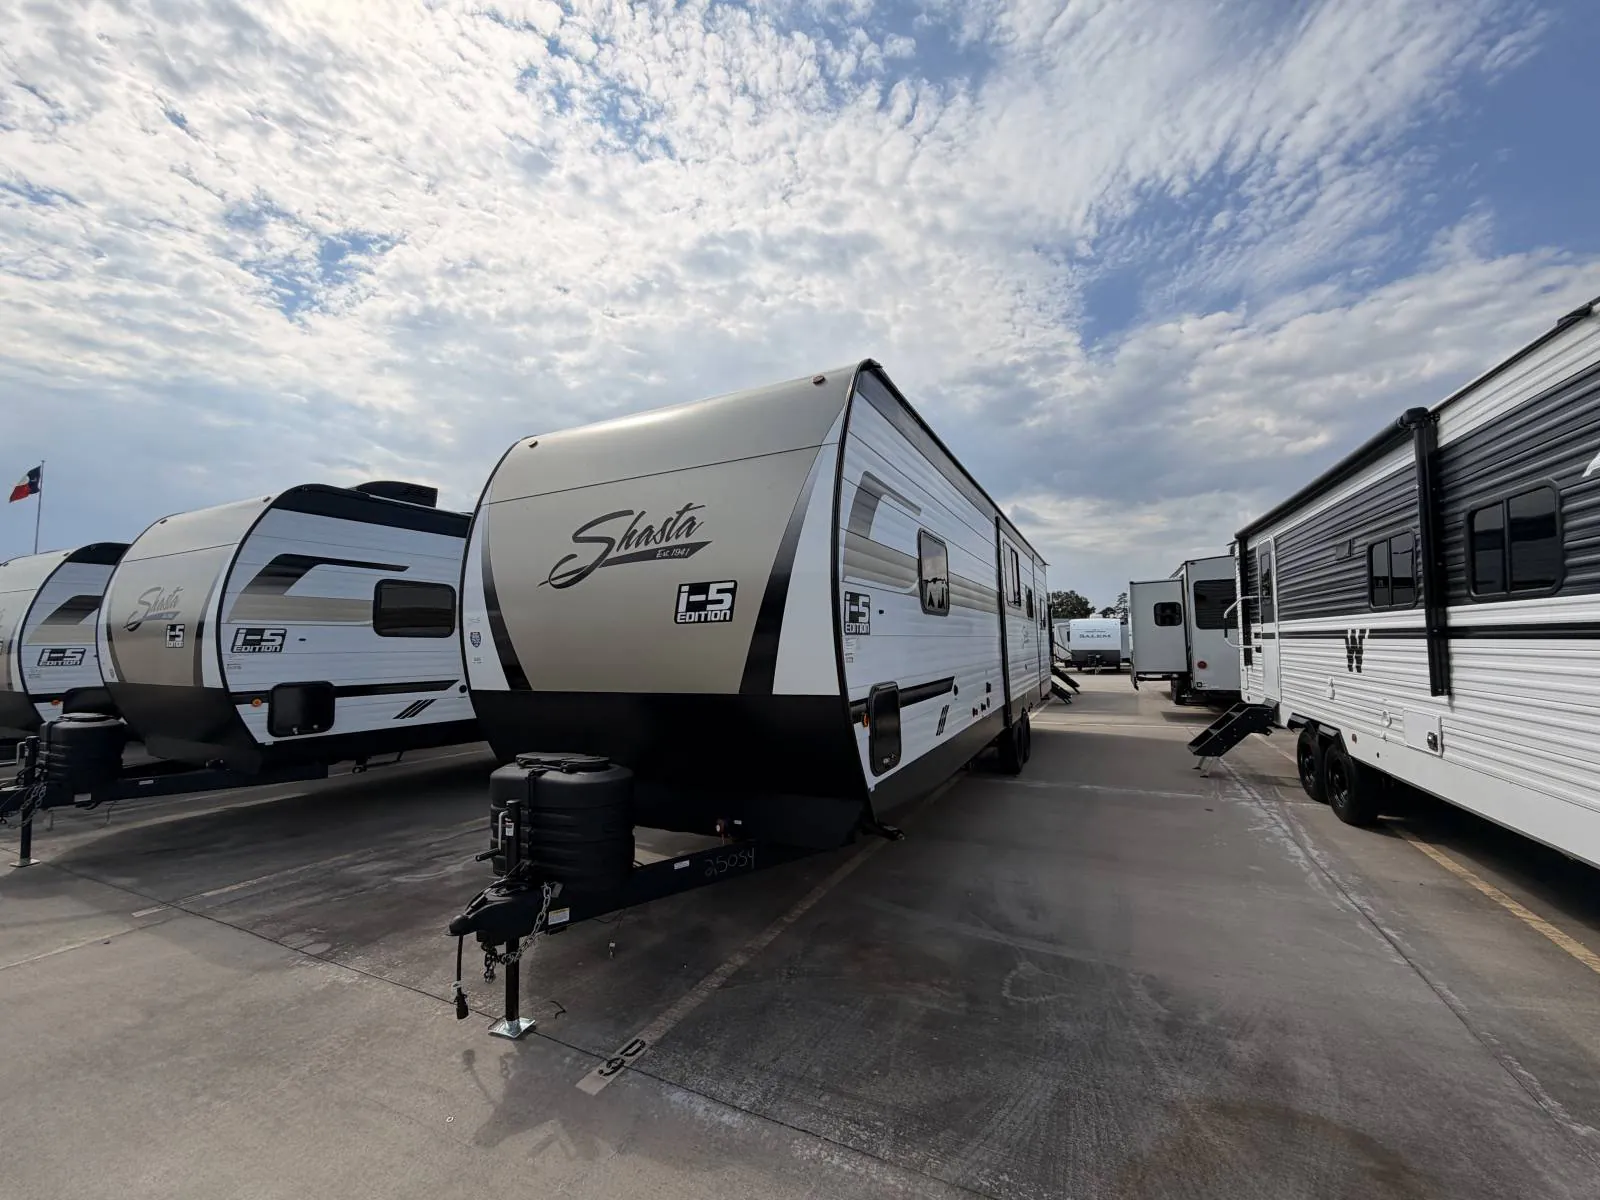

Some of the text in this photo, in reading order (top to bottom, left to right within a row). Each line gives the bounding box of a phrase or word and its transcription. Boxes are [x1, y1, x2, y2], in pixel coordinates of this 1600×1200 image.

[537, 503, 706, 589] Shasta
[678, 582, 735, 612] i-5
[677, 610, 731, 622] EDITION
[845, 622, 870, 634] EDITION
